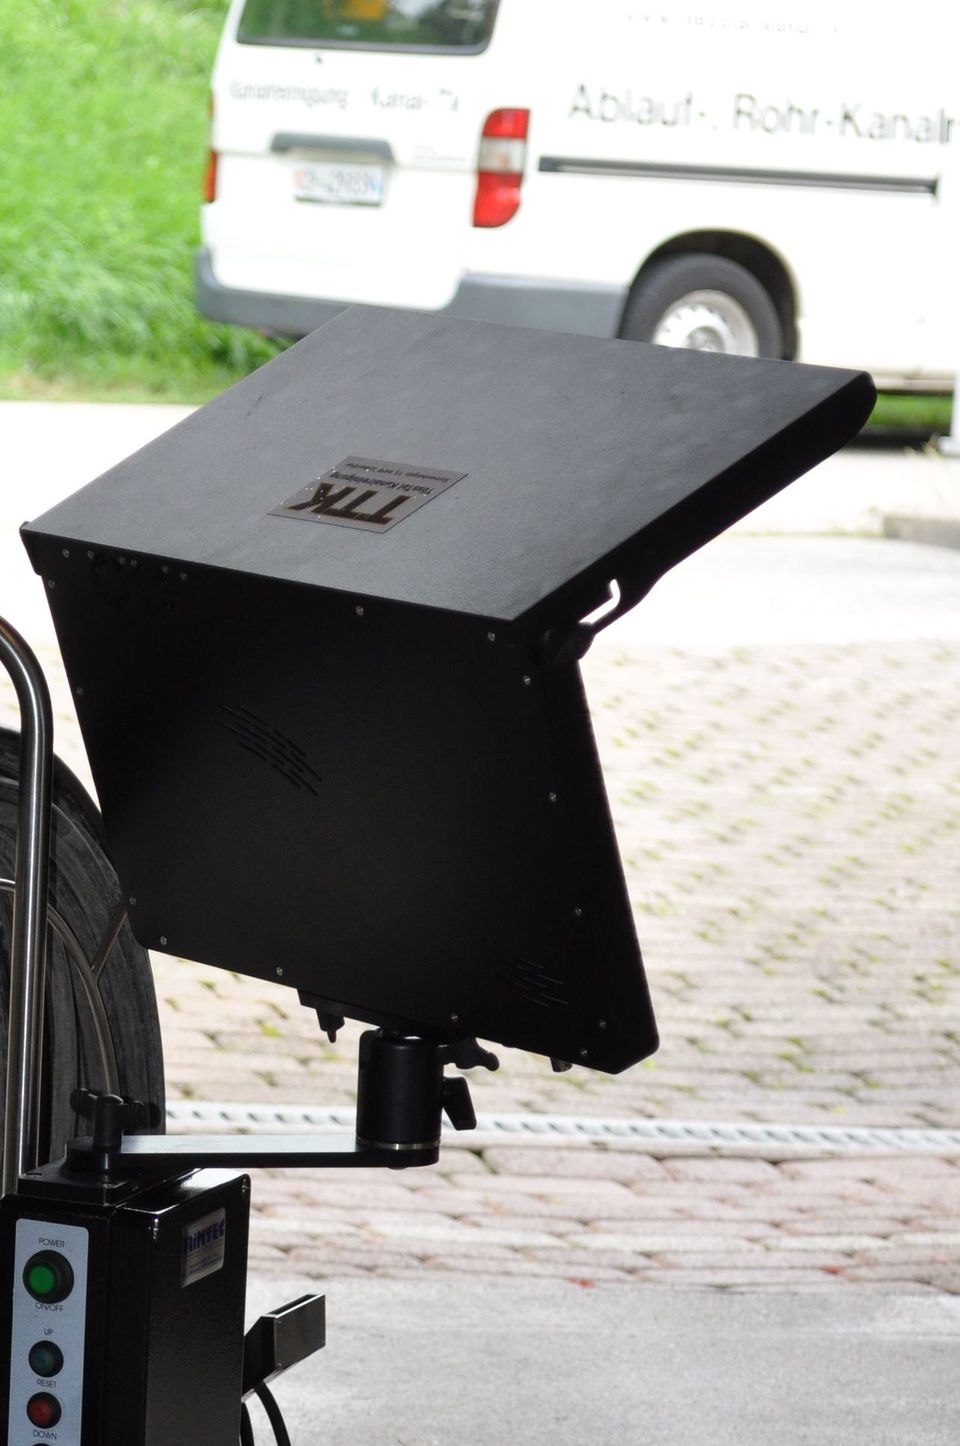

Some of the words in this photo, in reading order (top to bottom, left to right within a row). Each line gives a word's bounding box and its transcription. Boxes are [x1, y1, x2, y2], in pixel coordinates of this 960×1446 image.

[287, 482, 411, 525] TTK
[38, 1237, 65, 1248] POWER
[35, 1303, 64, 1312] ON/OFF
[43, 1328, 53, 1336] UP
[36, 1379, 57, 1388] RESET
[32, 1429, 57, 1440] DOWN
